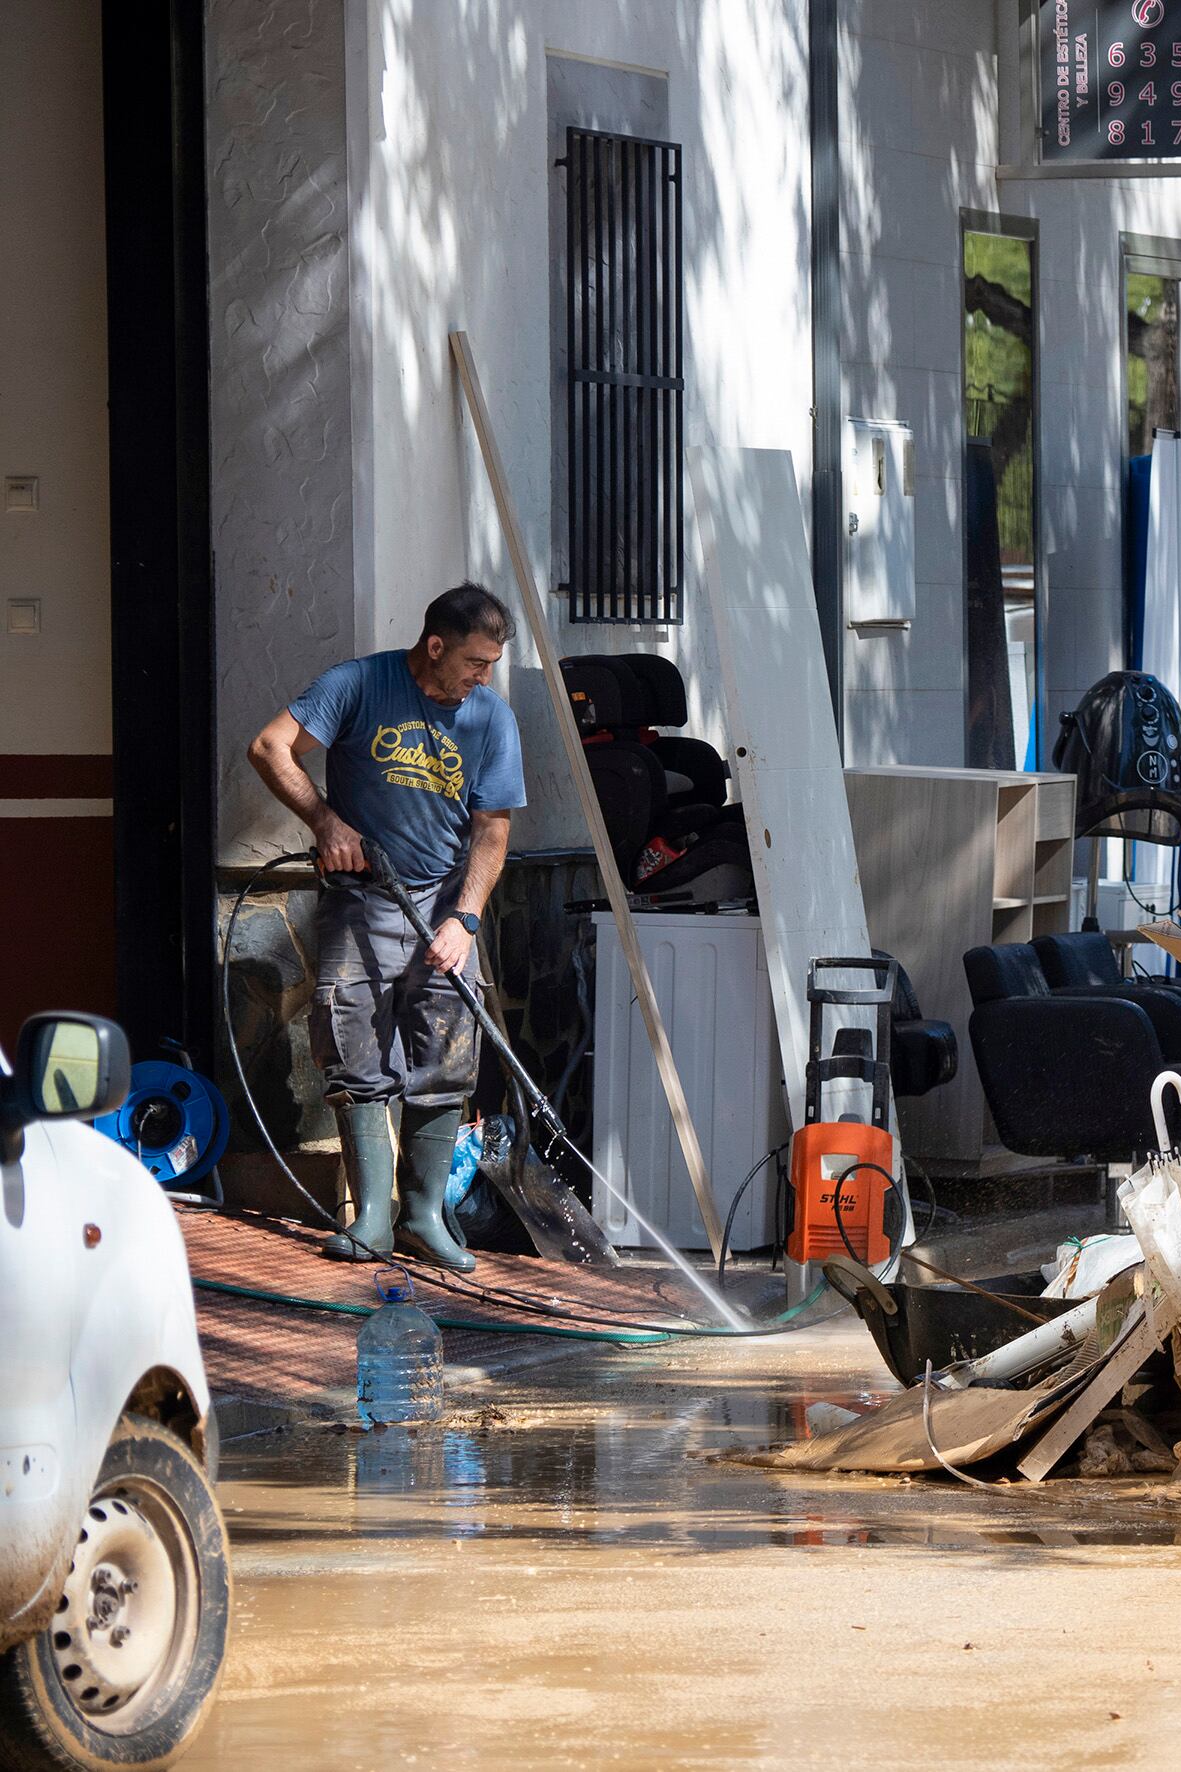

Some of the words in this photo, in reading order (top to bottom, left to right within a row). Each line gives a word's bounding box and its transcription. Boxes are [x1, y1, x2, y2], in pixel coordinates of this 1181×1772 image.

[1075, 33, 1088, 94] BELLEZA
[1057, 66, 1070, 86] DE
[1076, 96, 1088, 108] Y
[1057, 89, 1070, 146] CENTRO
[397, 720, 426, 733] CUSTOM
[440, 736, 459, 752] SHOP
[389, 774, 414, 787] SOUTH
[819, 1193, 857, 1204] STHL
